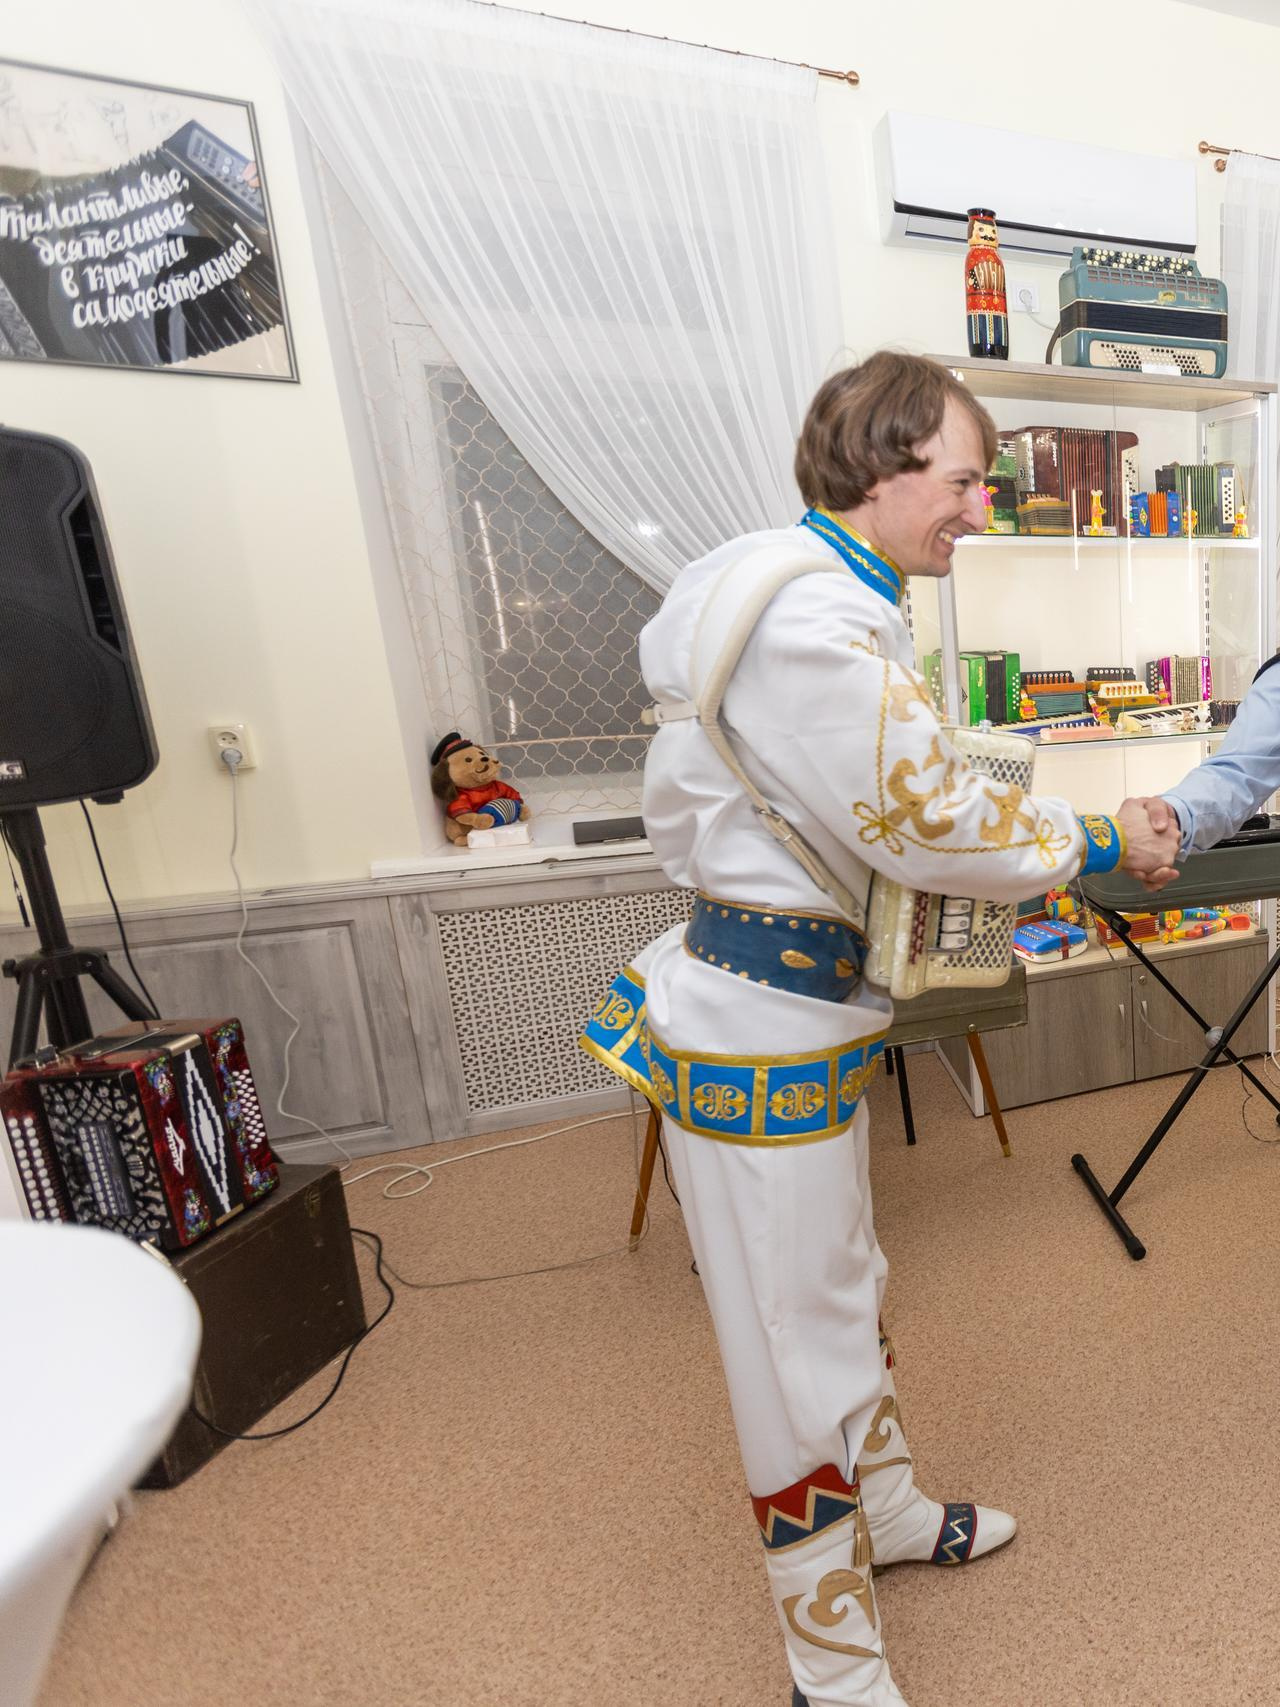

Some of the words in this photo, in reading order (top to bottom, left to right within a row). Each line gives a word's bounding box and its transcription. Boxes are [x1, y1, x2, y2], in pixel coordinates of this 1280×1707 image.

[61, 265, 79, 298] в
[82, 236, 188, 294] кружки
[72, 222, 261, 328] самодеятельные!
